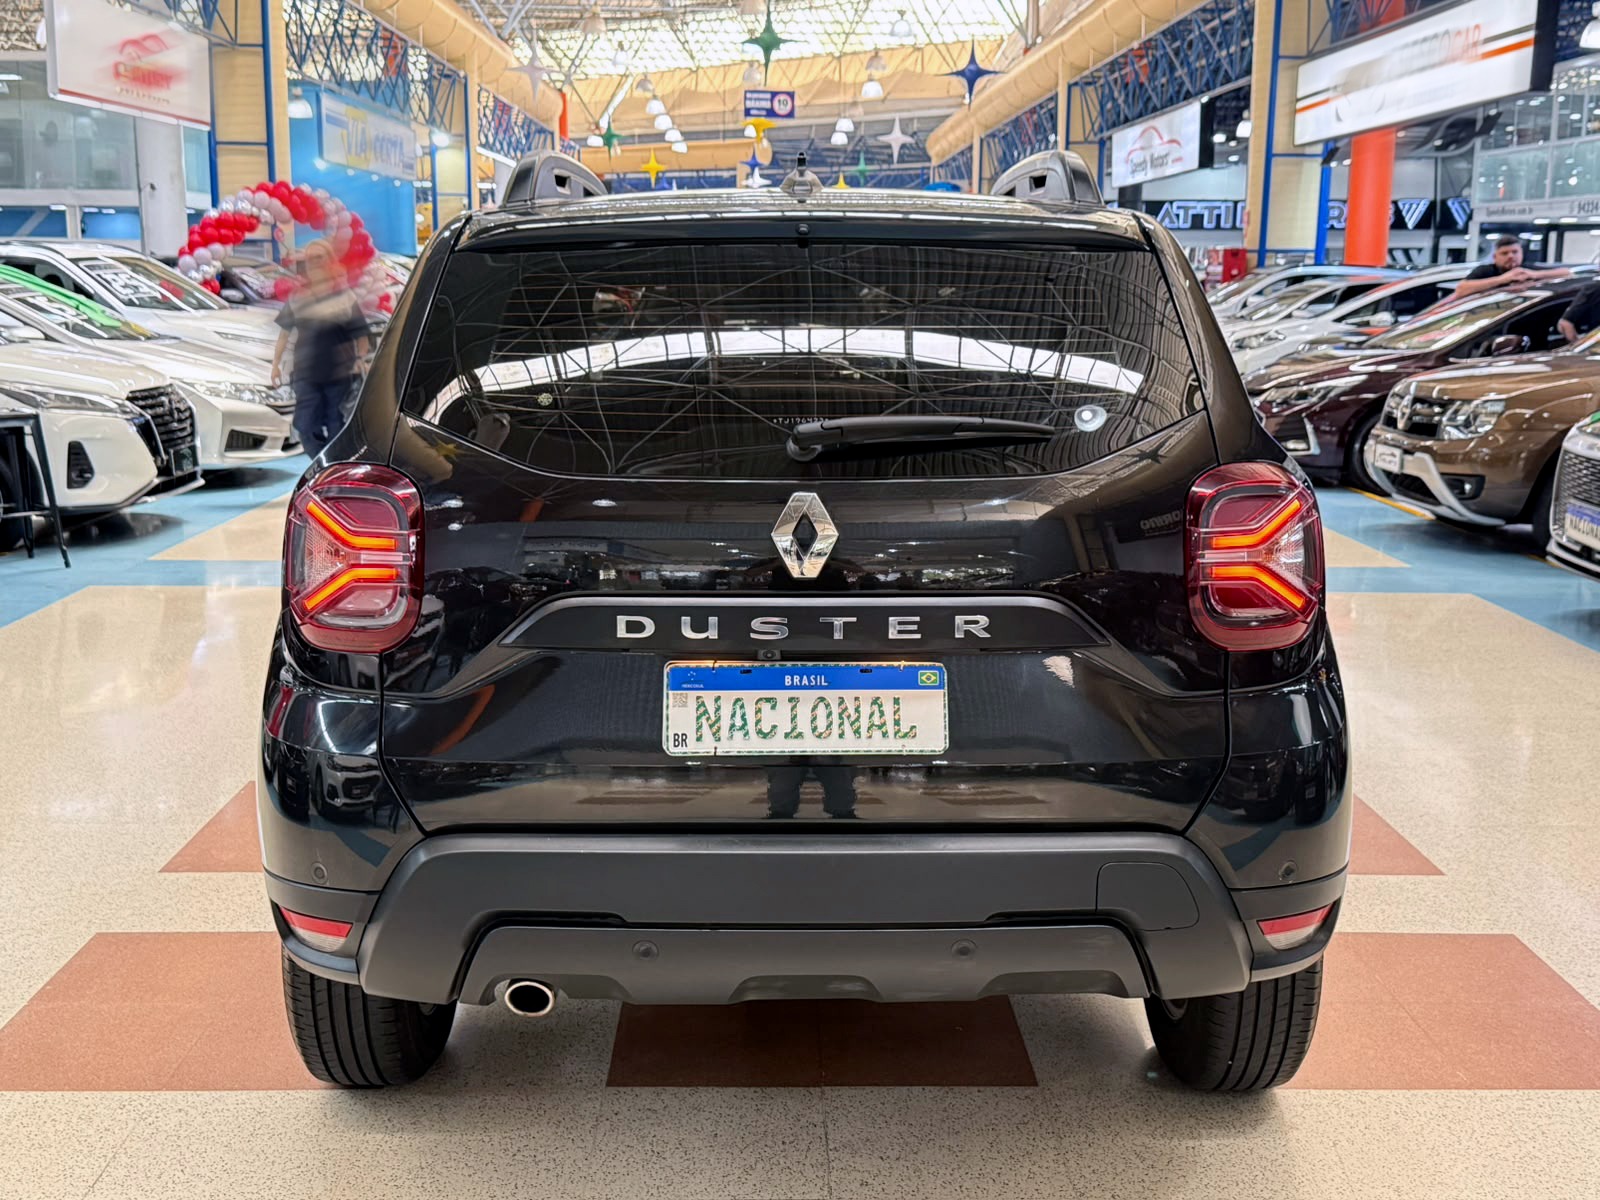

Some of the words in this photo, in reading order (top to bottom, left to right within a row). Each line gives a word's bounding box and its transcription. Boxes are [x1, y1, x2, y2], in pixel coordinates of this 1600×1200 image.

[1569, 516, 1600, 540] NACIONA
[616, 614, 992, 641] DUSTER
[784, 674, 829, 687] BRASIL
[695, 694, 918, 743] NACIONAL
[673, 732, 688, 748] BR
